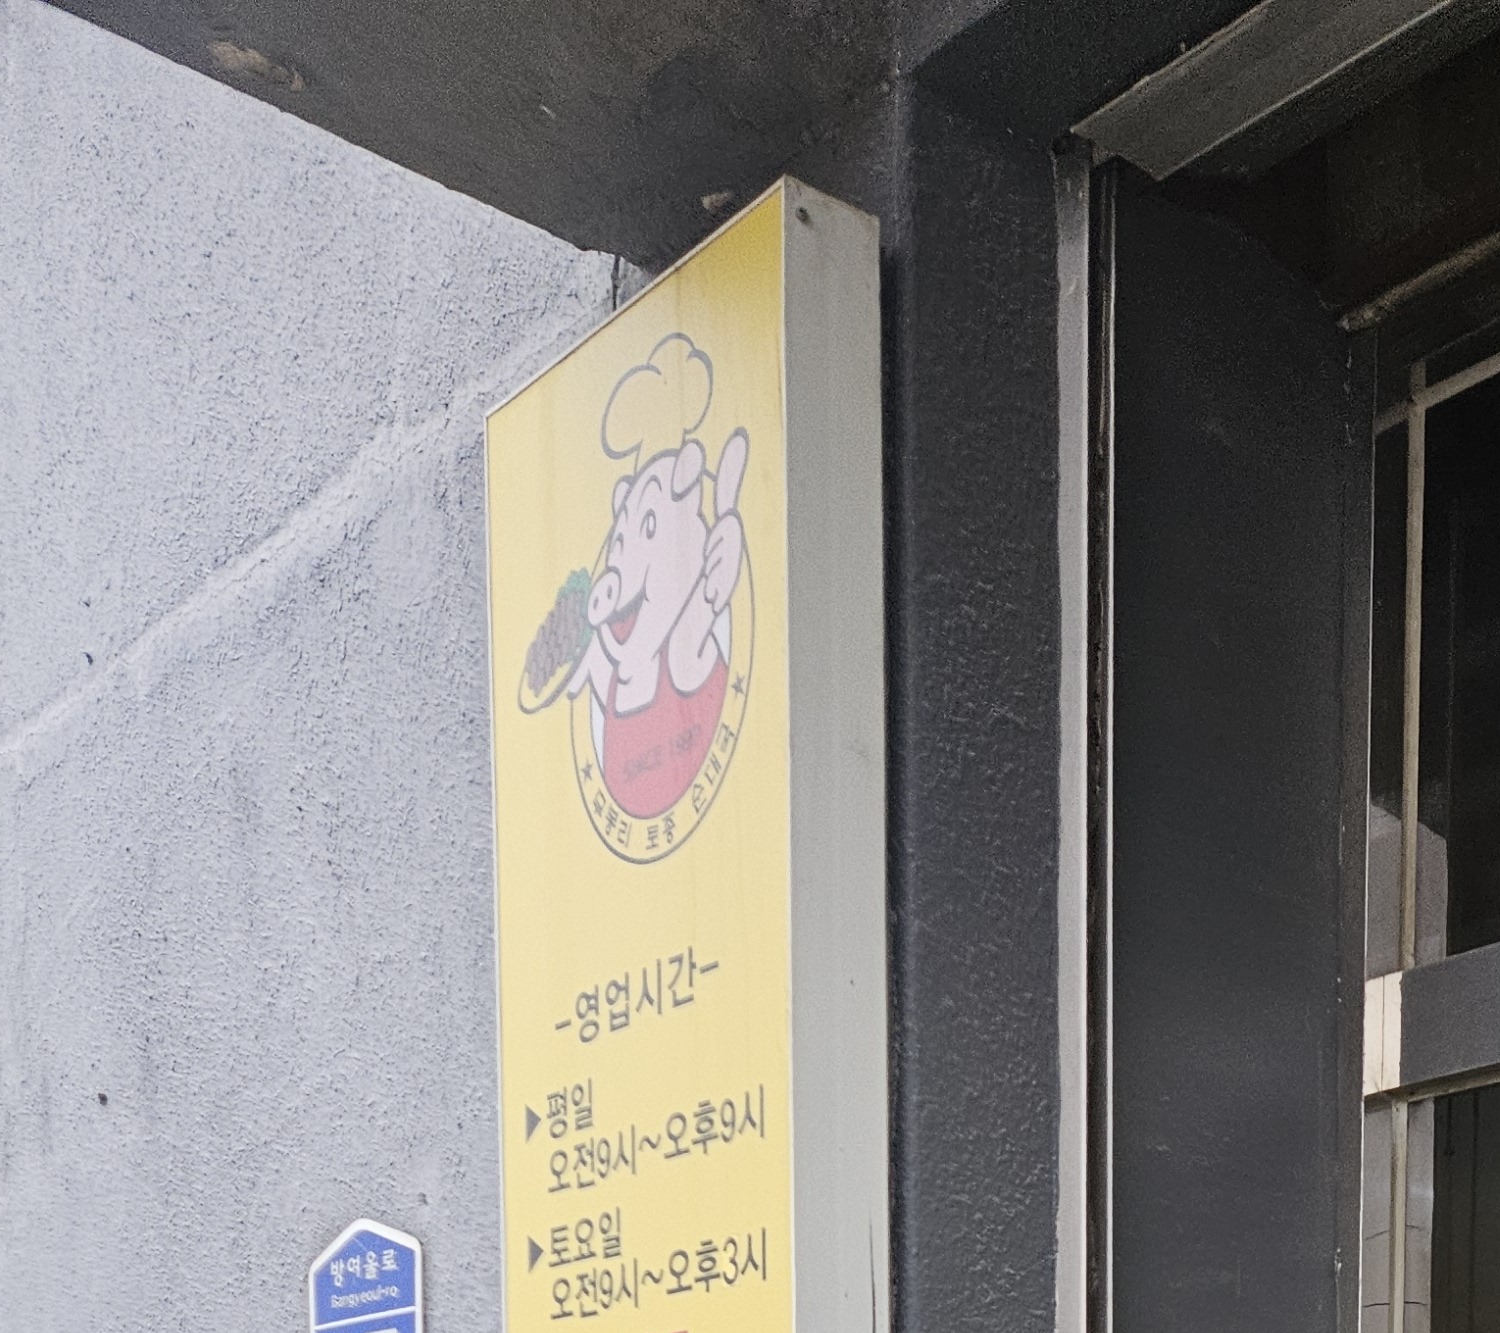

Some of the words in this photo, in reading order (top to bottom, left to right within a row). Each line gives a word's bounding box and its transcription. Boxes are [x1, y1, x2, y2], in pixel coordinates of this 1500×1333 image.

[593, 787, 632, 848] 무봉리
[646, 811, 676, 850] 토종
[692, 722, 735, 814] 순대국
[546, 1078, 594, 1139] 평일
[548, 1206, 623, 1268] 토요일
[330, 1249, 399, 1287] 방여울로
